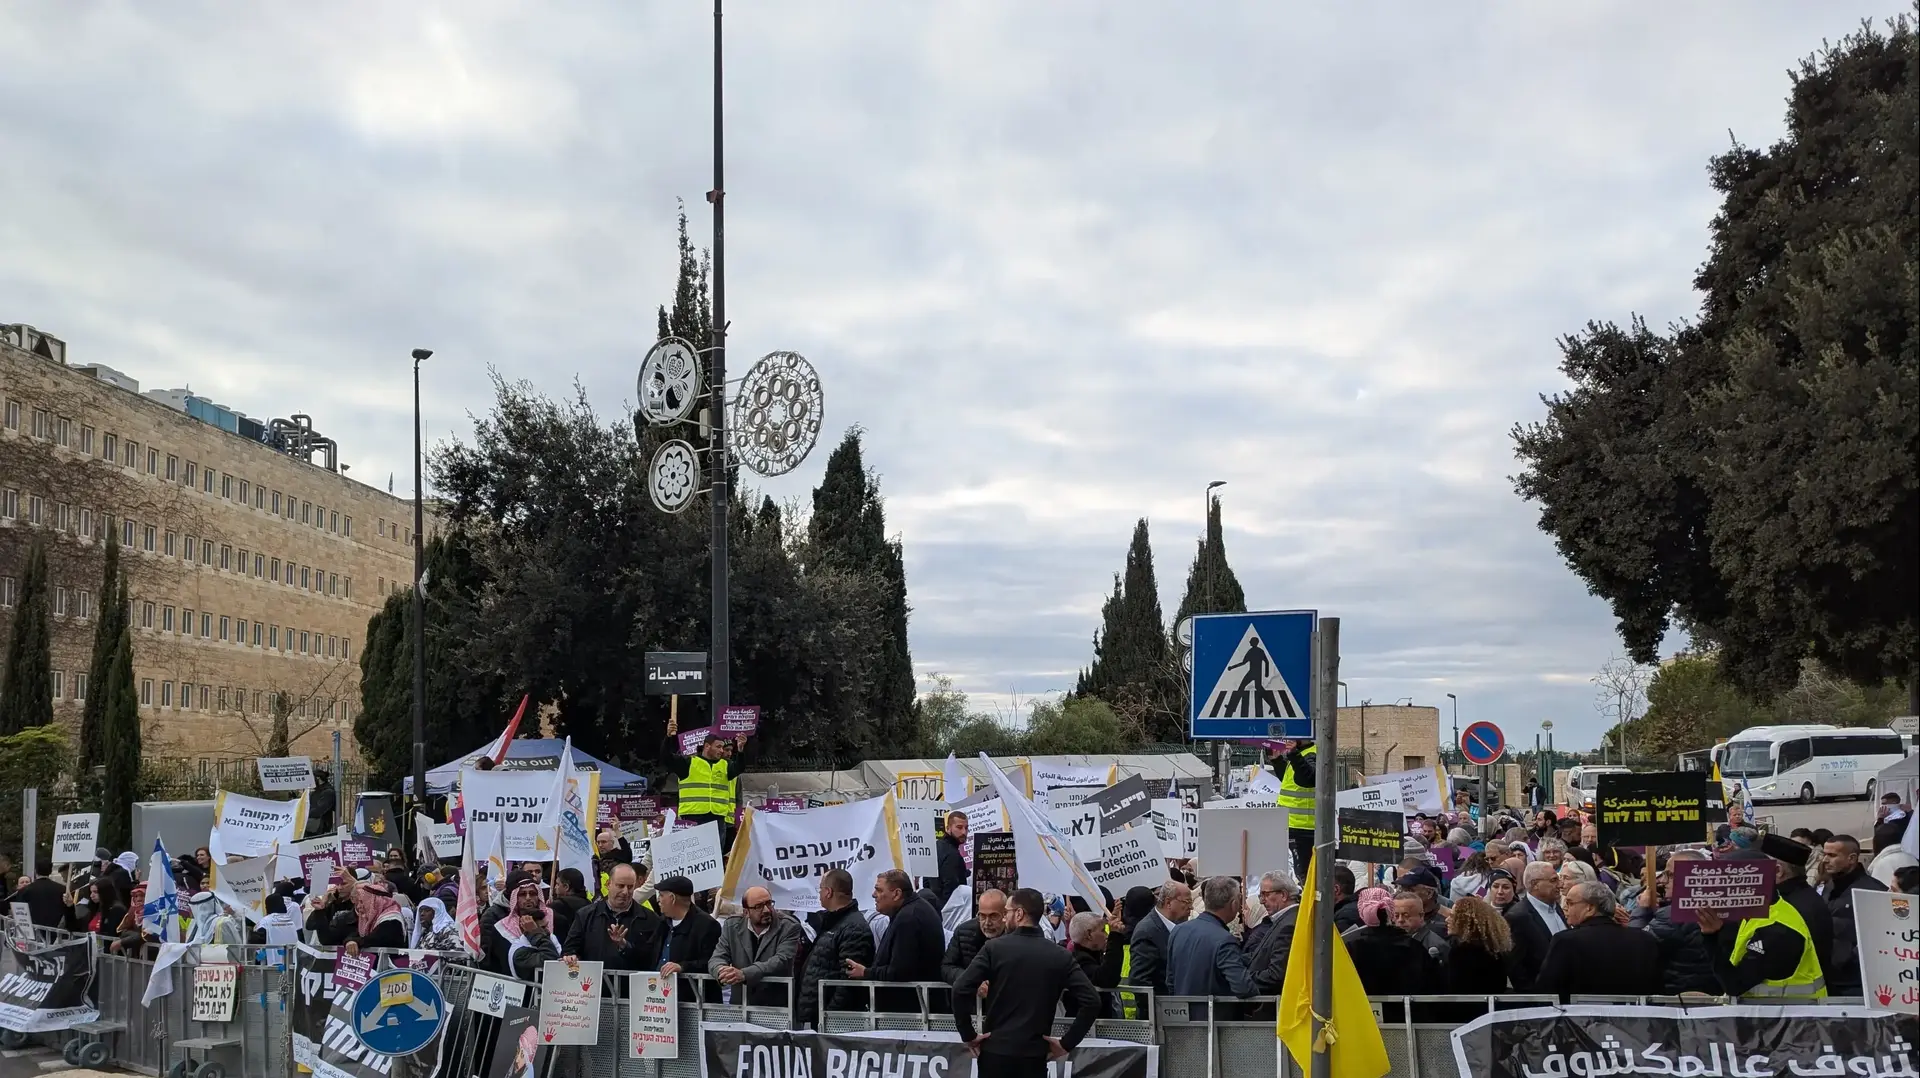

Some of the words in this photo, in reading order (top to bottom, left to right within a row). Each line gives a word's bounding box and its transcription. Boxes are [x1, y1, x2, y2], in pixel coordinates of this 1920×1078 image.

[530, 758, 553, 766] our
[496, 796, 537, 808] ערבים
[1603, 797, 1647, 809] مشتركة
[1650, 796, 1699, 808] مسؤولية
[239, 808, 280, 821] תקווה!
[1603, 810, 1630, 823] לזה
[1634, 810, 1652, 822] זה
[1656, 809, 1699, 822] ערבים
[62, 821, 71, 830] We
[73, 820, 90, 829] seek
[224, 817, 244, 827] הבא
[246, 822, 275, 832] הנרצח
[1072, 813, 1095, 836] לא
[1342, 825, 1368, 835] مشتركة
[1369, 828, 1400, 838] مسؤولية
[56, 832, 92, 844] protection.
[838, 837, 860, 851] חיי
[1126, 839, 1139, 848] מי
[1342, 835, 1357, 844] לזה
[1360, 836, 1370, 845] זה
[1372, 838, 1400, 848] ערבים
[63, 843, 81, 852] NOW.
[776, 841, 832, 860] ערבים
[1108, 844, 1123, 858] יתן
[1103, 850, 1147, 869] otection
[1142, 858, 1158, 869] מה
[687, 859, 716, 875] הוצאה
[758, 863, 808, 882] שווים!
[1691, 864, 1722, 877] دموية
[1724, 864, 1759, 876] حكومة
[1094, 864, 1141, 883] rotection
[1719, 876, 1760, 884] ממשלת
[1691, 888, 1724, 898] جميعًا
[1727, 887, 1756, 897] تقتلنا
[1681, 898, 1708, 908] כולנו
[1730, 897, 1762, 905] הורגת
[224, 967, 234, 982] לא
[220, 984, 231, 999] לא
[386, 982, 408, 998] 400
[193, 1001, 210, 1018] רבין
[211, 1001, 227, 1014] רצח
[644, 1004, 667, 1014] אחראית
[632, 1032, 654, 1041] הערבית
[655, 1034, 675, 1043] בחברה
[827, 1048, 949, 1078] RIGHTS
